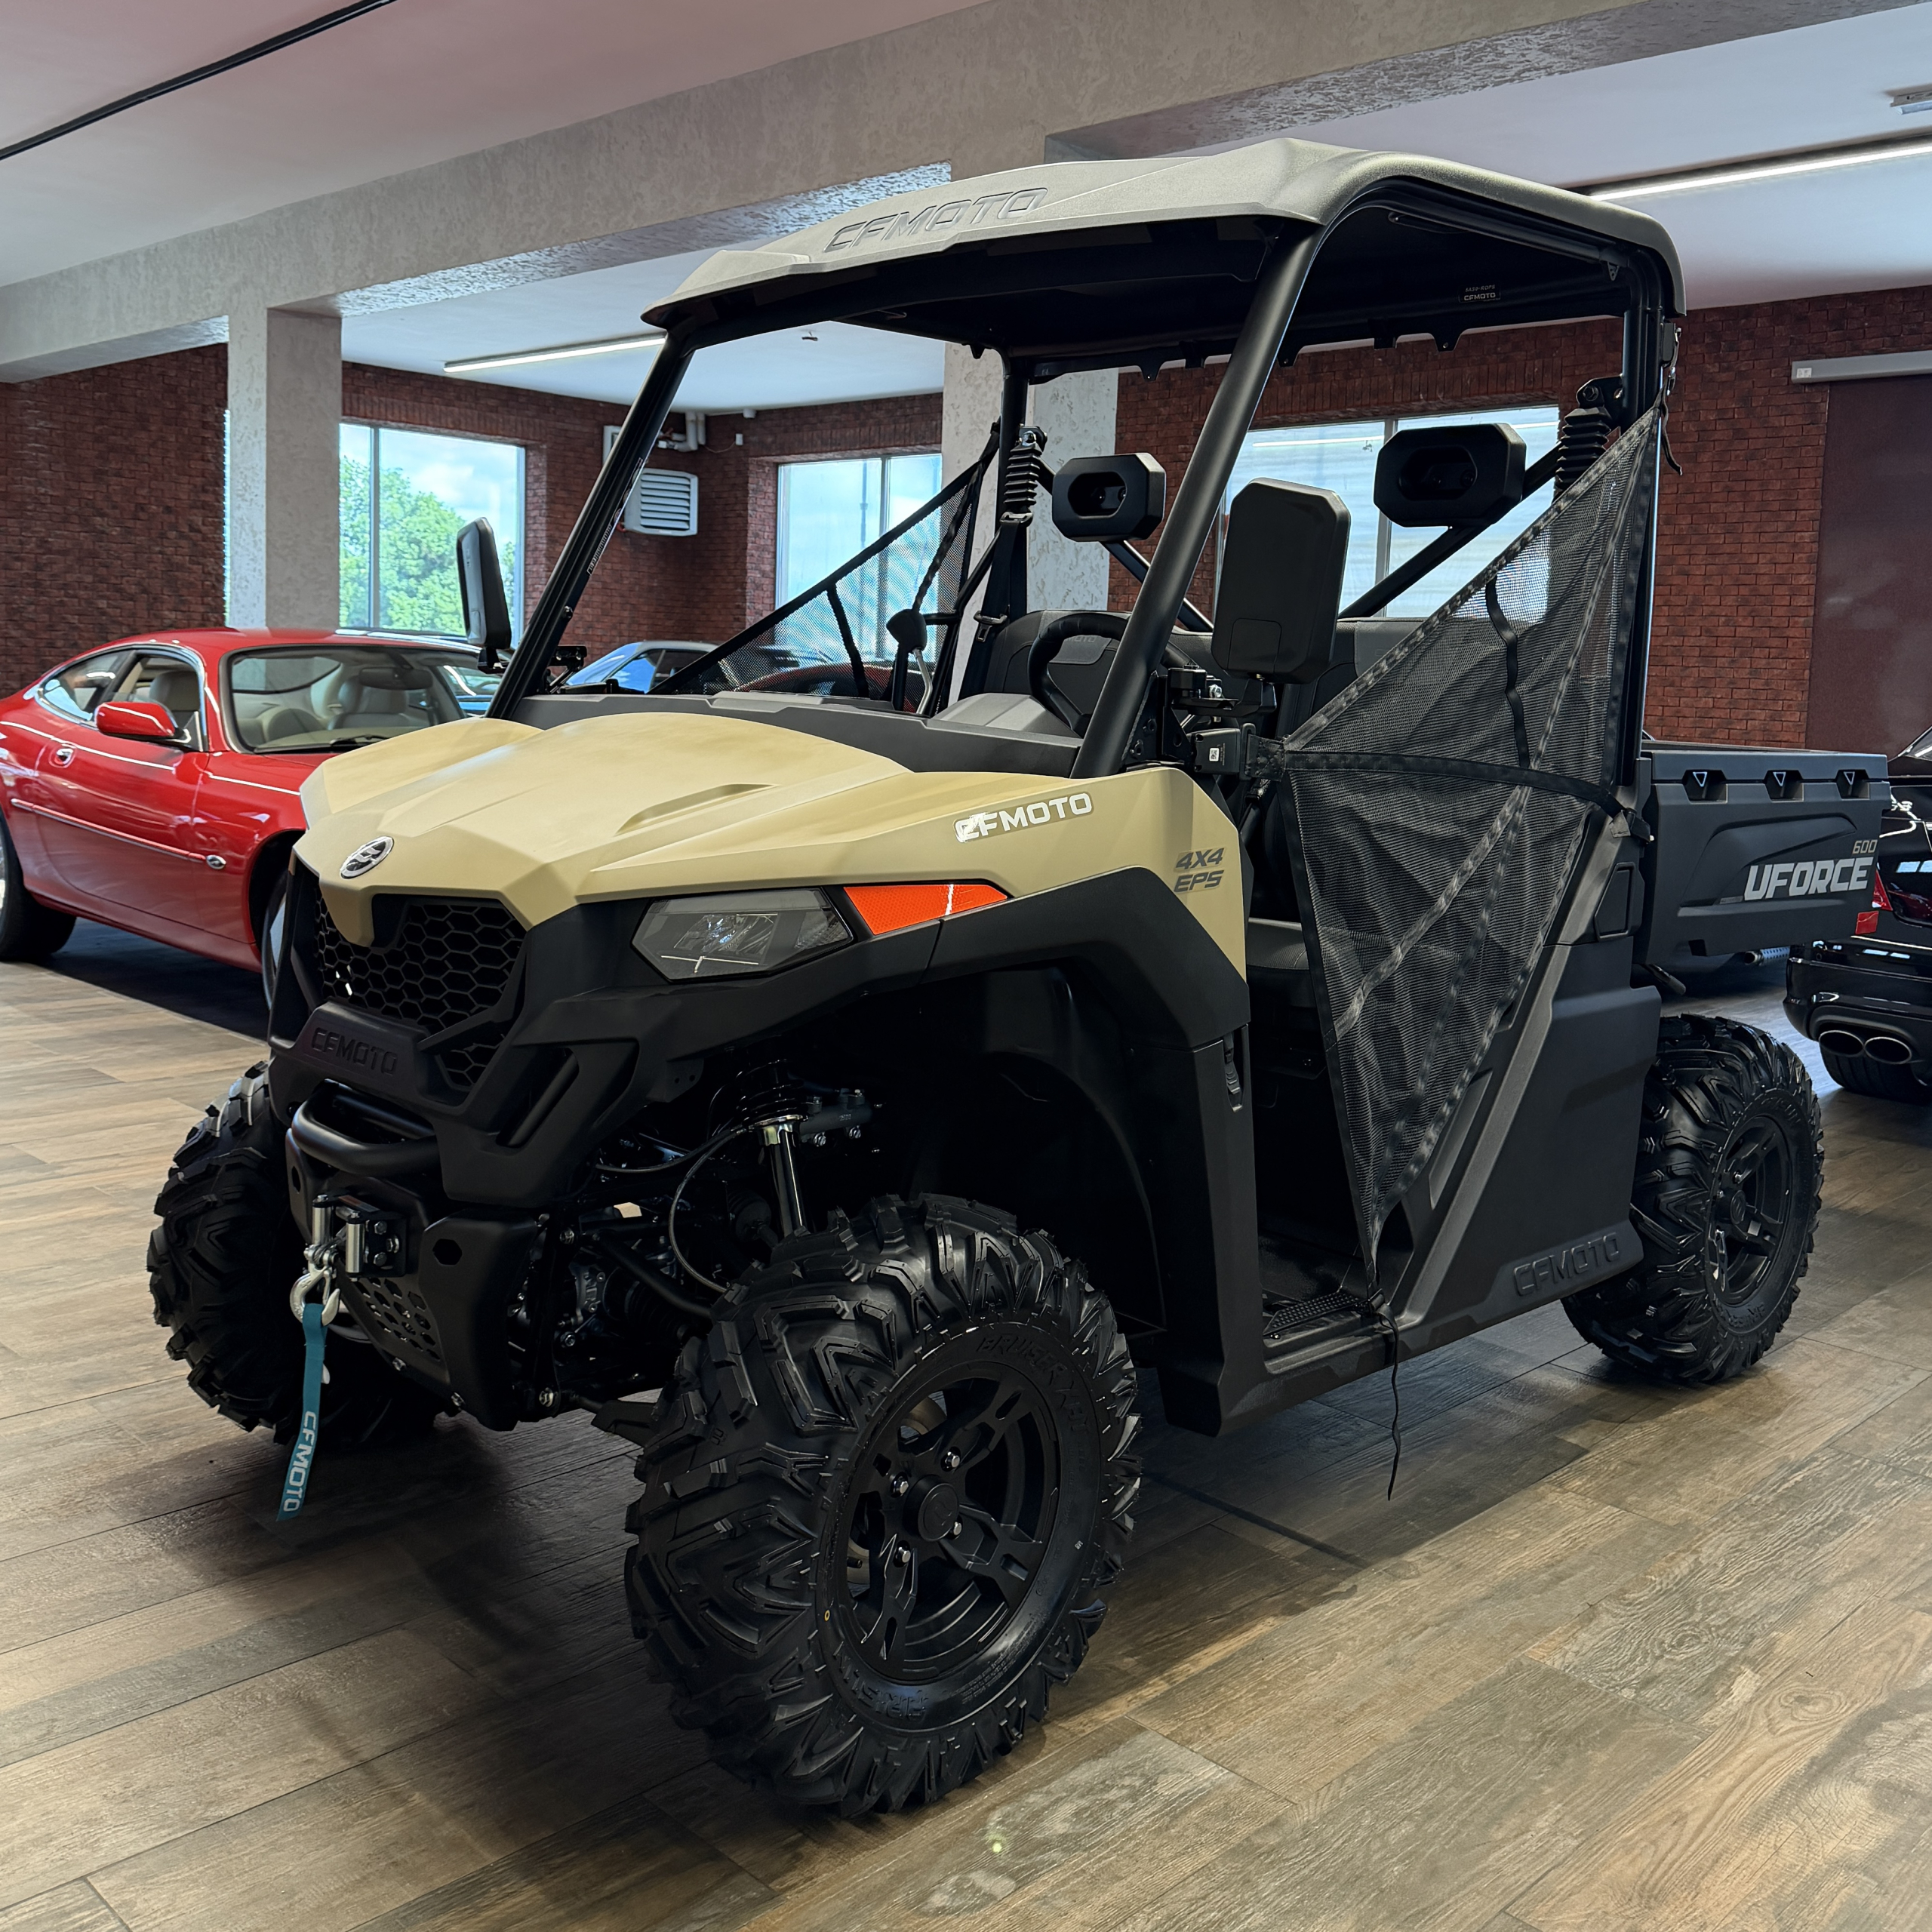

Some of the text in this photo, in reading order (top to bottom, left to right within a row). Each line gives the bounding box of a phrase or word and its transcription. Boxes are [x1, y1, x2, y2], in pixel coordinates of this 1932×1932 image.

[823, 187, 1048, 252] CFMOTO
[1464, 292, 1497, 301] CFMOTO
[1176, 848, 1225, 869] 4X4
[1852, 839, 1878, 854] 600
[1174, 870, 1225, 893] EPS
[1744, 857, 1874, 901] UFORCE
[311, 1027, 398, 1075] CFMOTO
[1513, 1232, 1620, 1297] CFMOTO
[282, 1411, 316, 1512] CFMOTO
